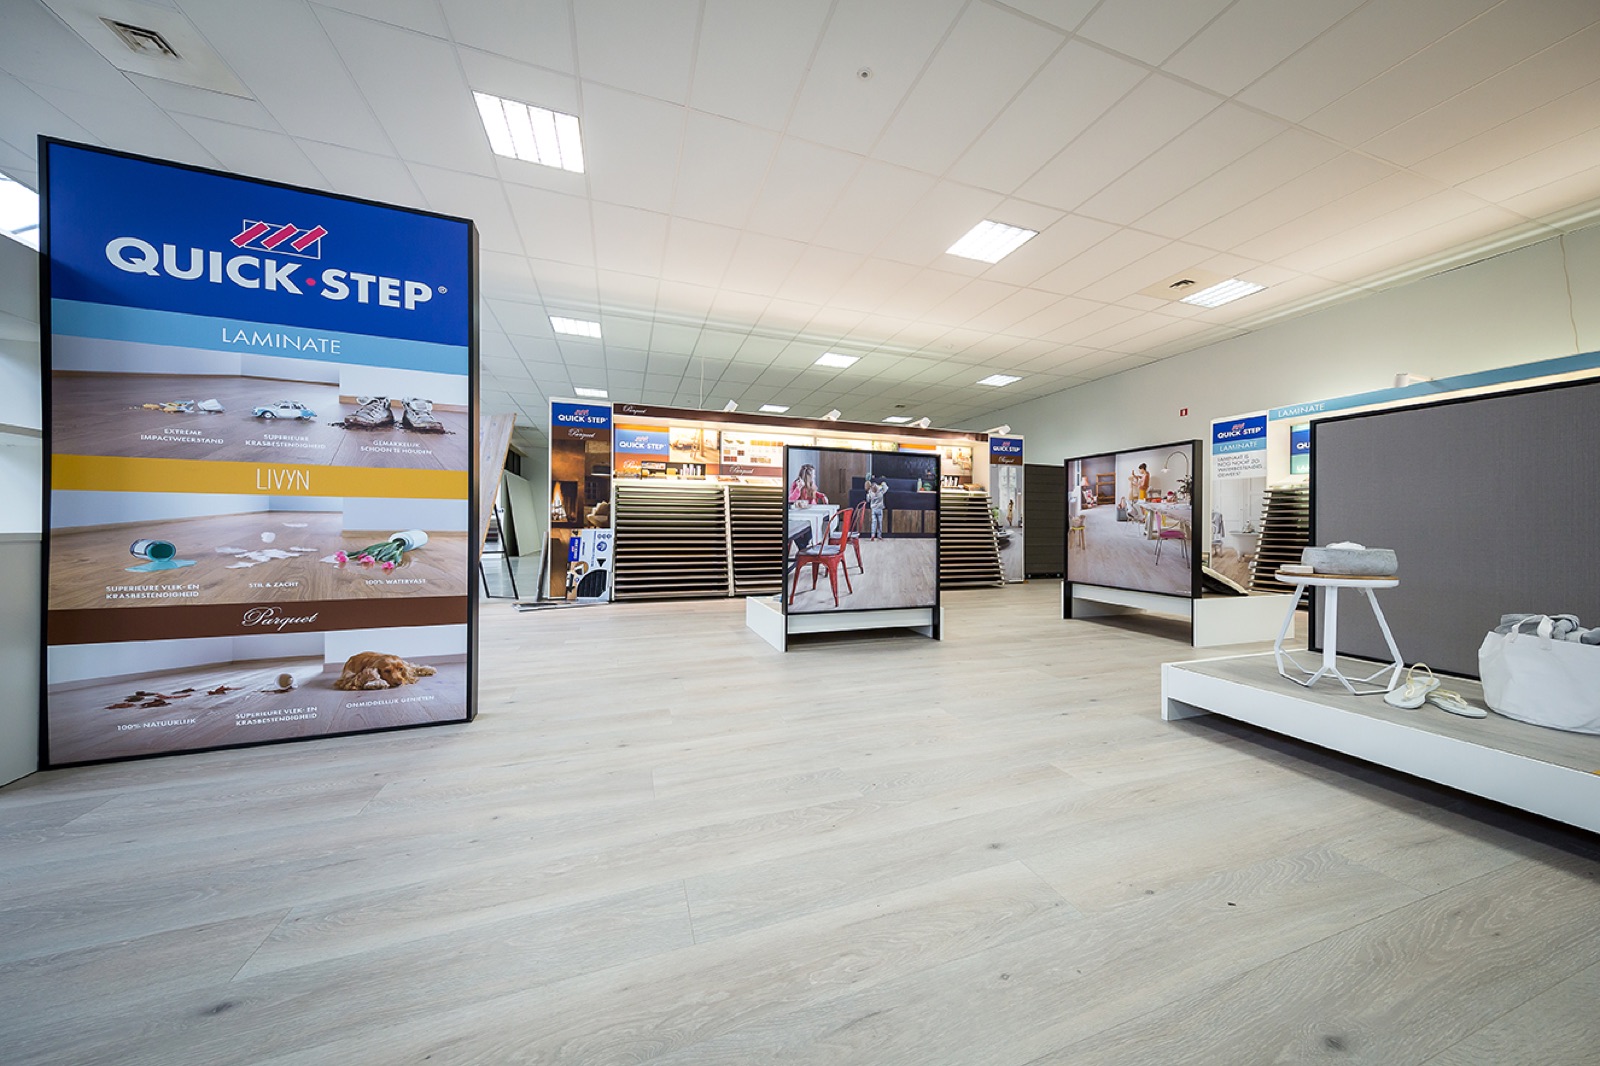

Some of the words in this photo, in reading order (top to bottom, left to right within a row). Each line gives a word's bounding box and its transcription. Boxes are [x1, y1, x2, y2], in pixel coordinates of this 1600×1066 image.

[222, 327, 341, 356] LAMINATE
[1278, 403, 1326, 418] LAMINATE
[164, 428, 202, 436] EXTREME
[140, 434, 224, 445] IMPACTWEERSTAND
[263, 433, 309, 442] SUPERIEURE
[245, 440, 327, 450] KRASBESTENDIGHEID
[373, 439, 421, 448] GEMAKKELIJK
[1219, 441, 1258, 452] LAMINATE
[256, 468, 310, 491] LIVYN
[106, 585, 159, 593] SUPERIEURE
[105, 590, 200, 599] KRASBESTENDIGHEID
[241, 606, 319, 631] Parquet
[401, 695, 435, 703] GENIETEN
[235, 710, 282, 719] SUPERIEURE
[235, 713, 318, 727] KRASBESTENDIGHEID
[117, 723, 141, 731] 100%
